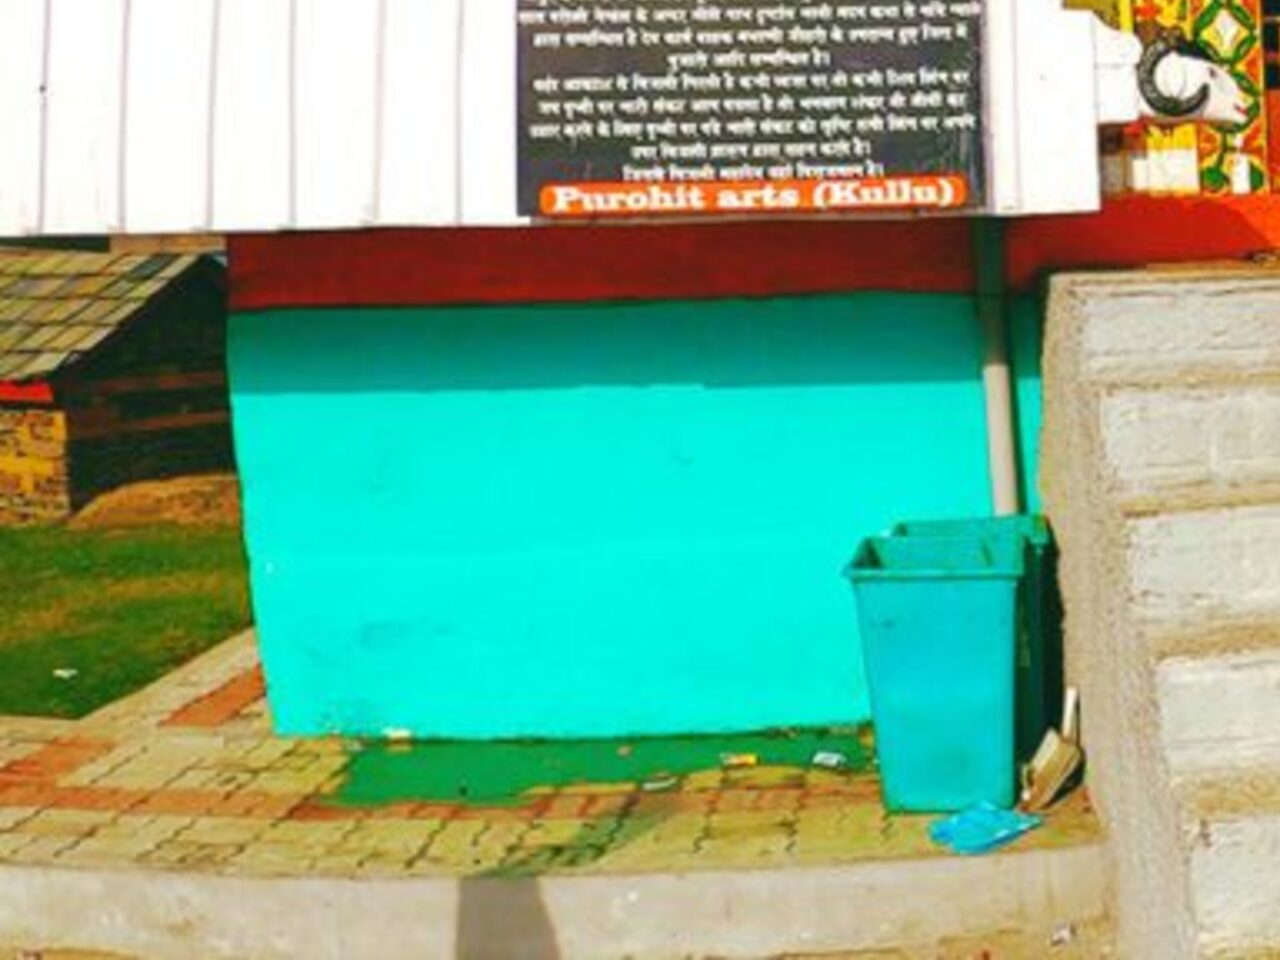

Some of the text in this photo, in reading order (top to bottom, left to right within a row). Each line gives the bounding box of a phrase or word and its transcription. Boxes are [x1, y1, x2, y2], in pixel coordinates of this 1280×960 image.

[553, 176, 955, 213] Purohit arts (Kullu)
